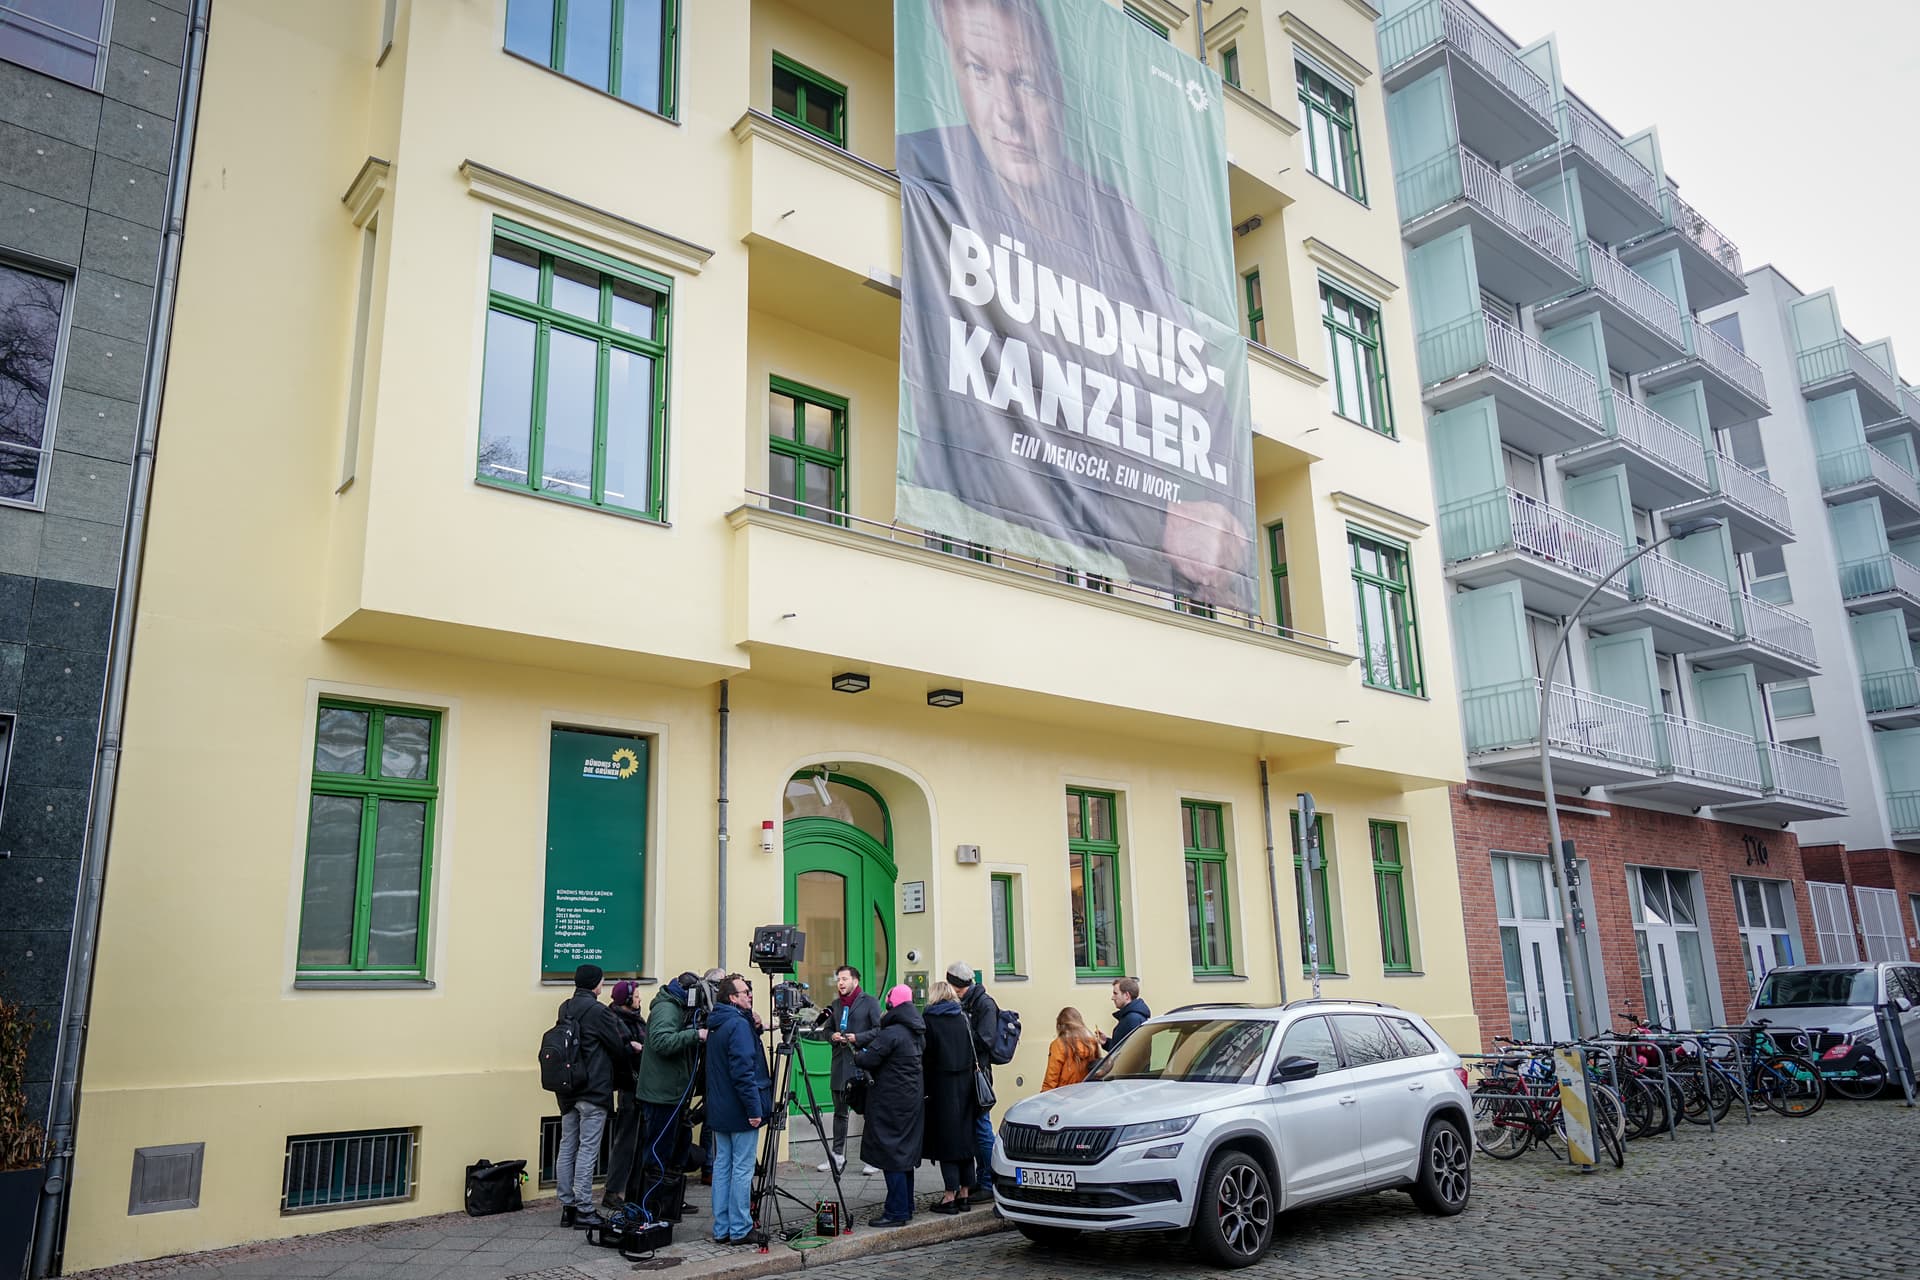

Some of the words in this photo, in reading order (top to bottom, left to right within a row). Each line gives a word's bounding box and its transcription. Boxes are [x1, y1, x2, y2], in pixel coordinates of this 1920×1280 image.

[949, 223, 1225, 393] BÜNDNIS-
[949, 316, 1228, 485] KANZLER.
[1010, 432, 1041, 459] EIN
[1042, 442, 1111, 482] MENSCH.
[1115, 465, 1139, 490] EIN
[1142, 472, 1182, 504] WORT.
[585, 758, 611, 767] BÜNDNIS
[595, 767, 619, 776] GRÜNEN
[971, 849, 977, 859] 1
[1022, 1170, 1028, 1183] B
[1033, 1171, 1046, 1185] RI
[1048, 1172, 1073, 1187] 1412
